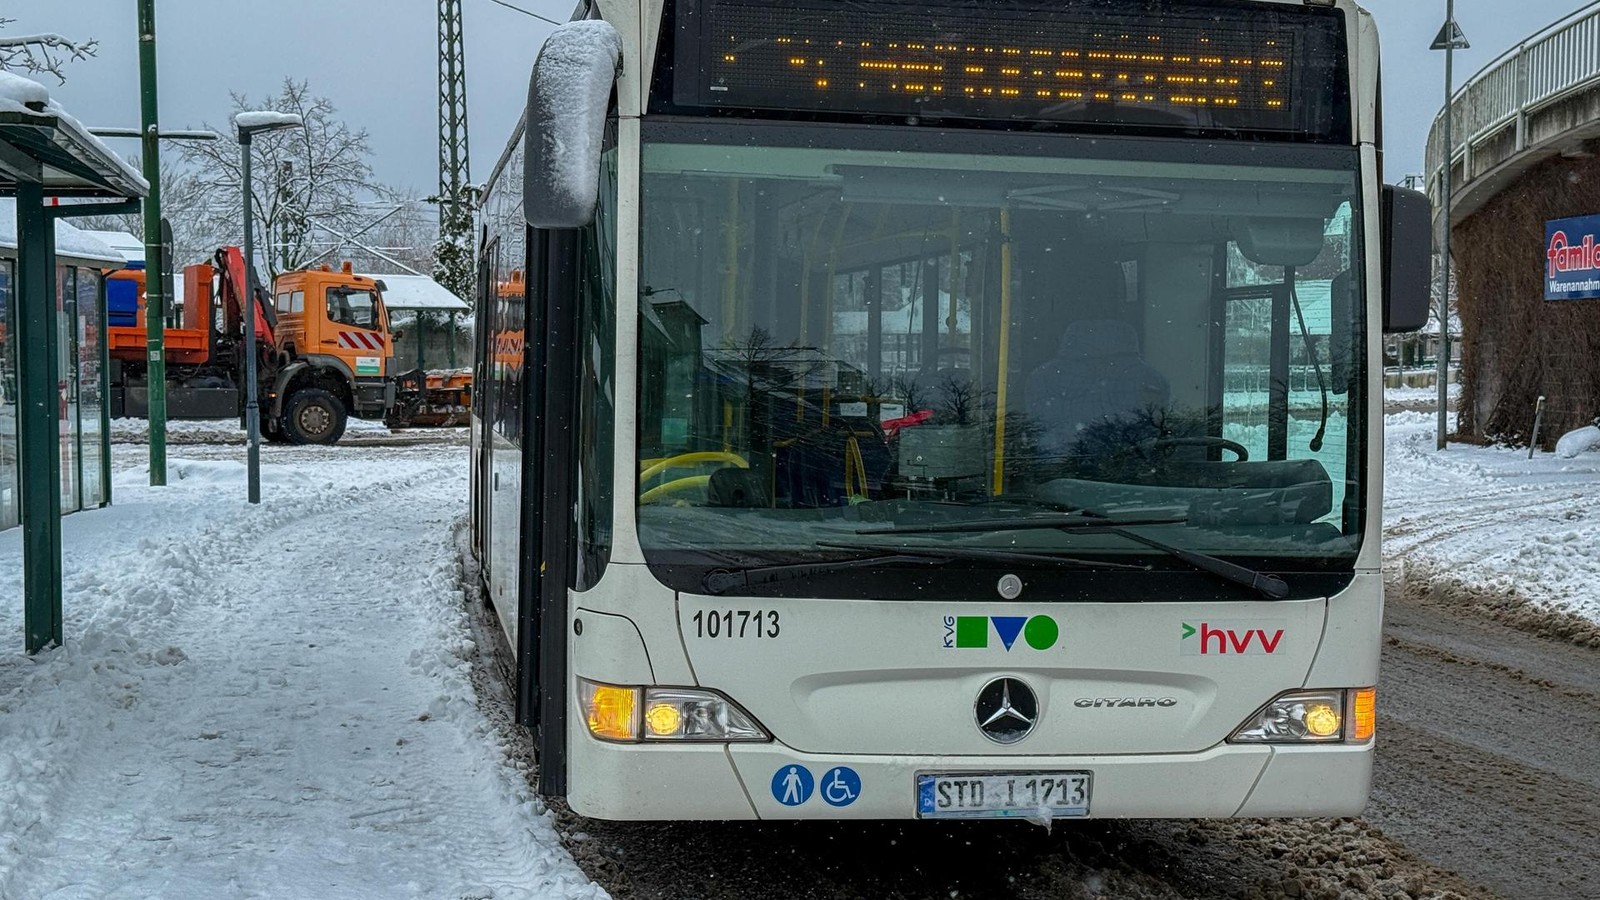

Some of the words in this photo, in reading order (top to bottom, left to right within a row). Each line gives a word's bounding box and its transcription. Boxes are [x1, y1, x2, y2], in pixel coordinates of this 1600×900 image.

[693, 610, 780, 638] 101713
[943, 615, 955, 648] KVG
[1073, 697, 1177, 708] CITARO
[937, 780, 984, 808] STD
[1025, 777, 1086, 806] 1713
